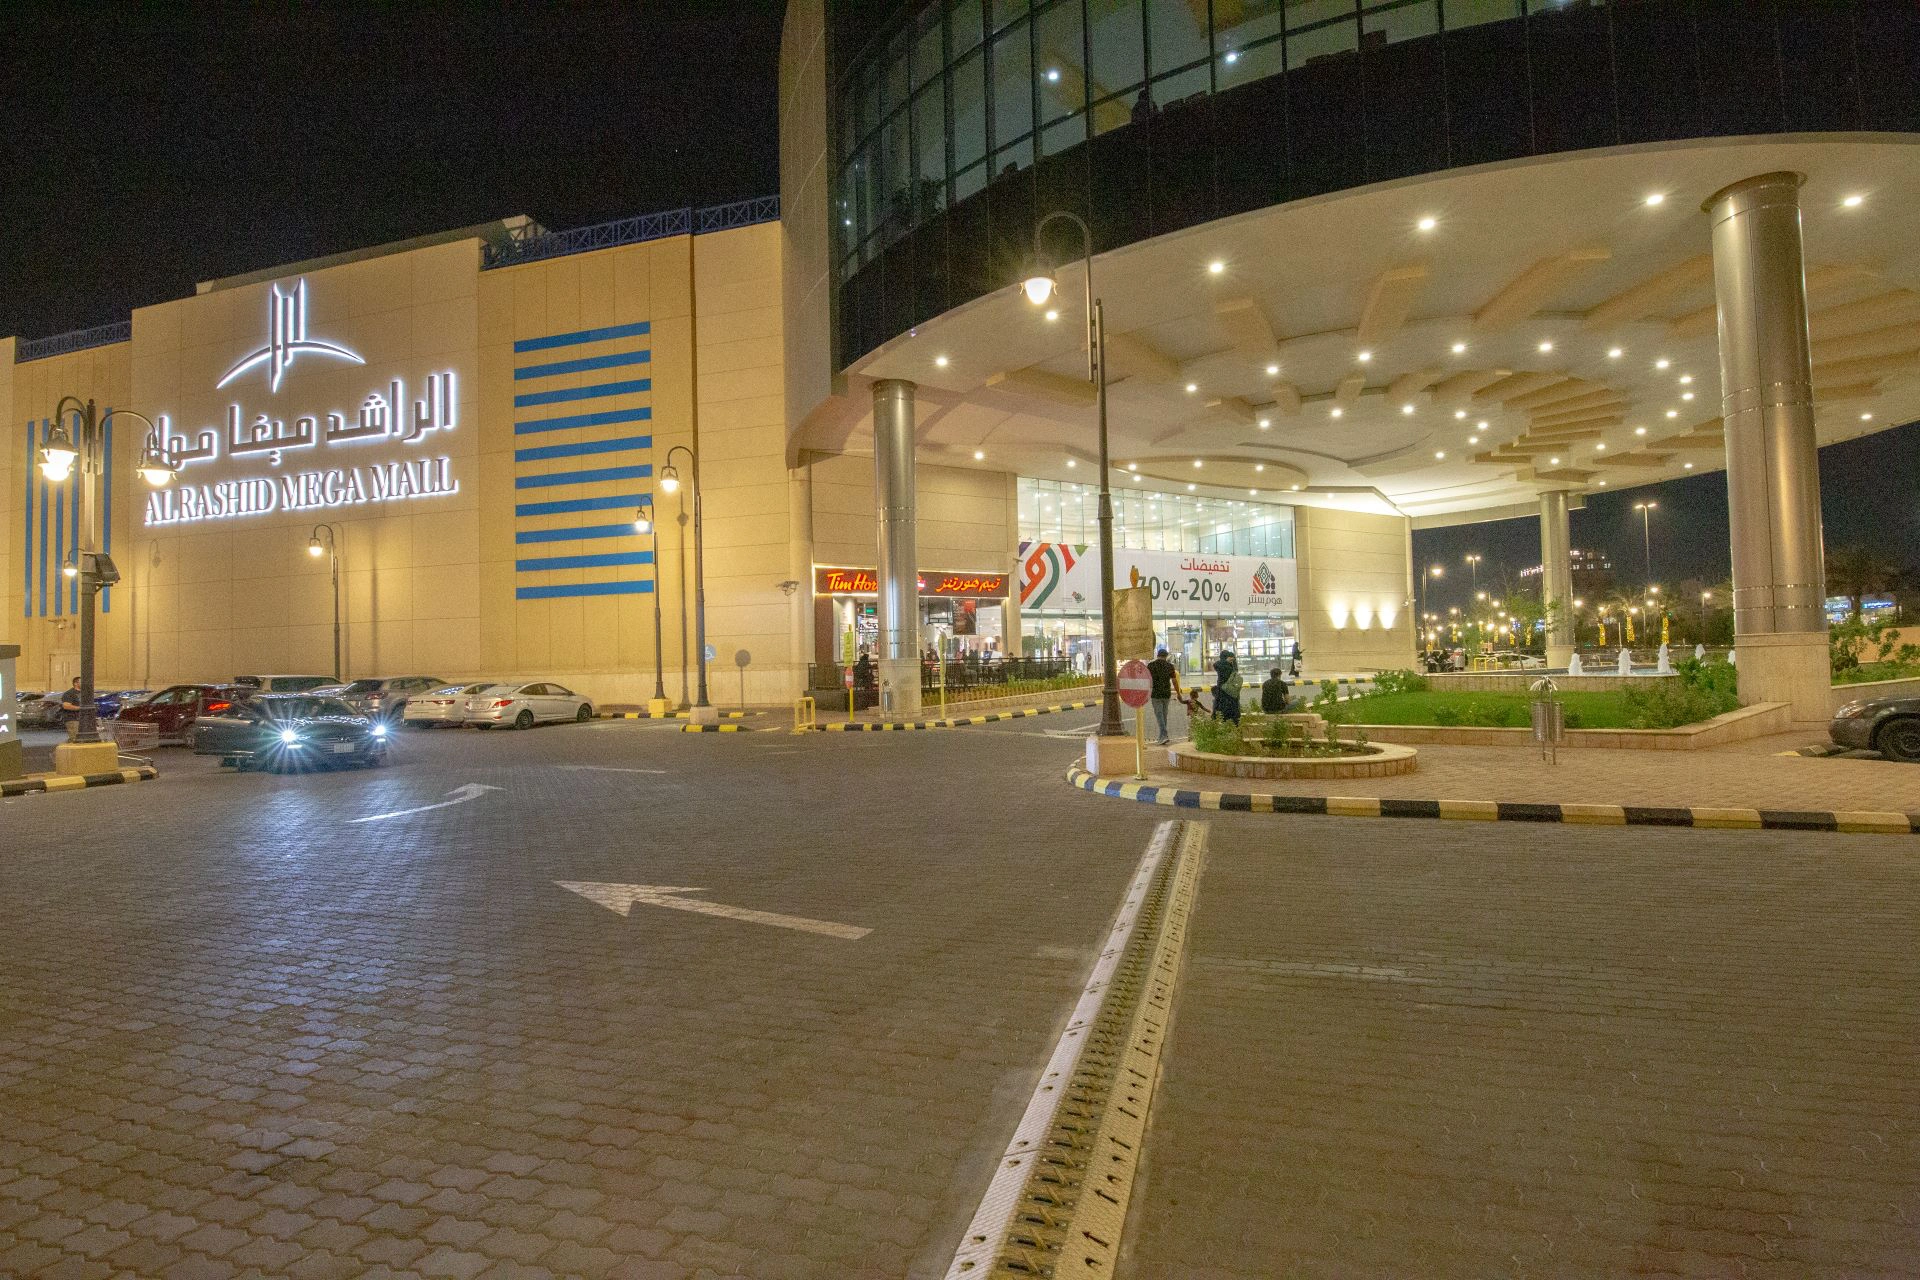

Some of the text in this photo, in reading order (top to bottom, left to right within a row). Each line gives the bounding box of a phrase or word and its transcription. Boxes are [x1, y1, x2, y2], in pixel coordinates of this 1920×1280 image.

[146, 372, 457, 471] الراشد ميغا مول
[280, 467, 366, 510] MEGA
[370, 457, 459, 500] MALL
[1180, 558, 1230, 575] تخفيضات
[827, 572, 852, 590] Tim
[935, 577, 1001, 593] تيم هورتنز
